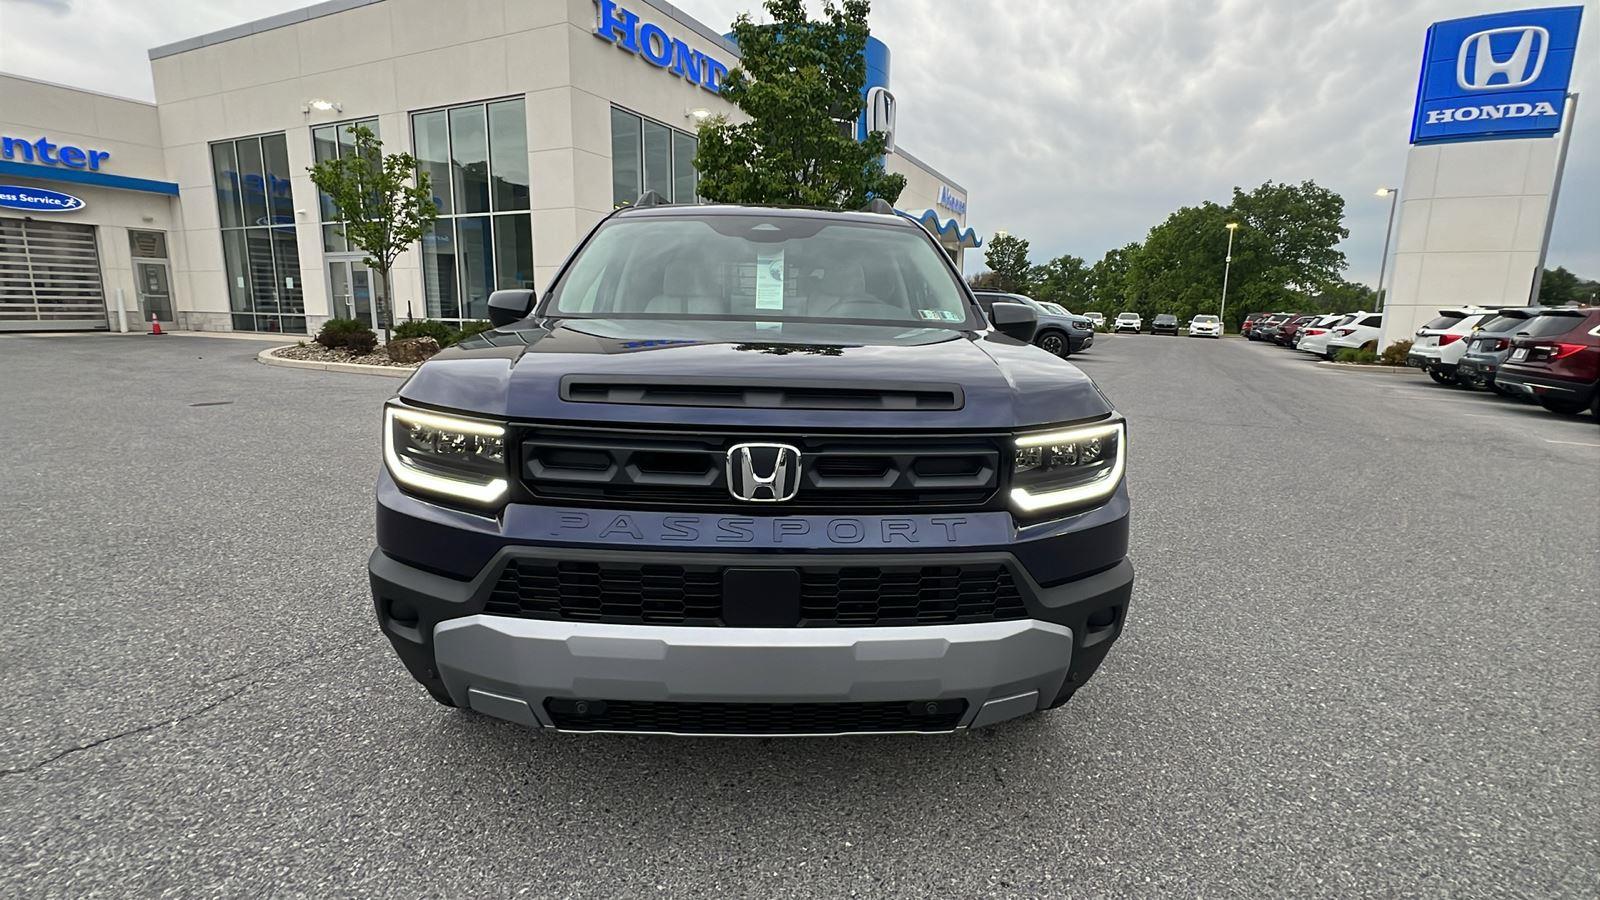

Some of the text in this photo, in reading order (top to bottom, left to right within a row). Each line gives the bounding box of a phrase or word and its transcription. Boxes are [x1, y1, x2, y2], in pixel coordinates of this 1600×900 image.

[597, 0, 730, 93] HOND
[1425, 102, 1558, 124] HONDA
[19, 194, 61, 205] Service
[550, 510, 967, 543] PASSPORT
